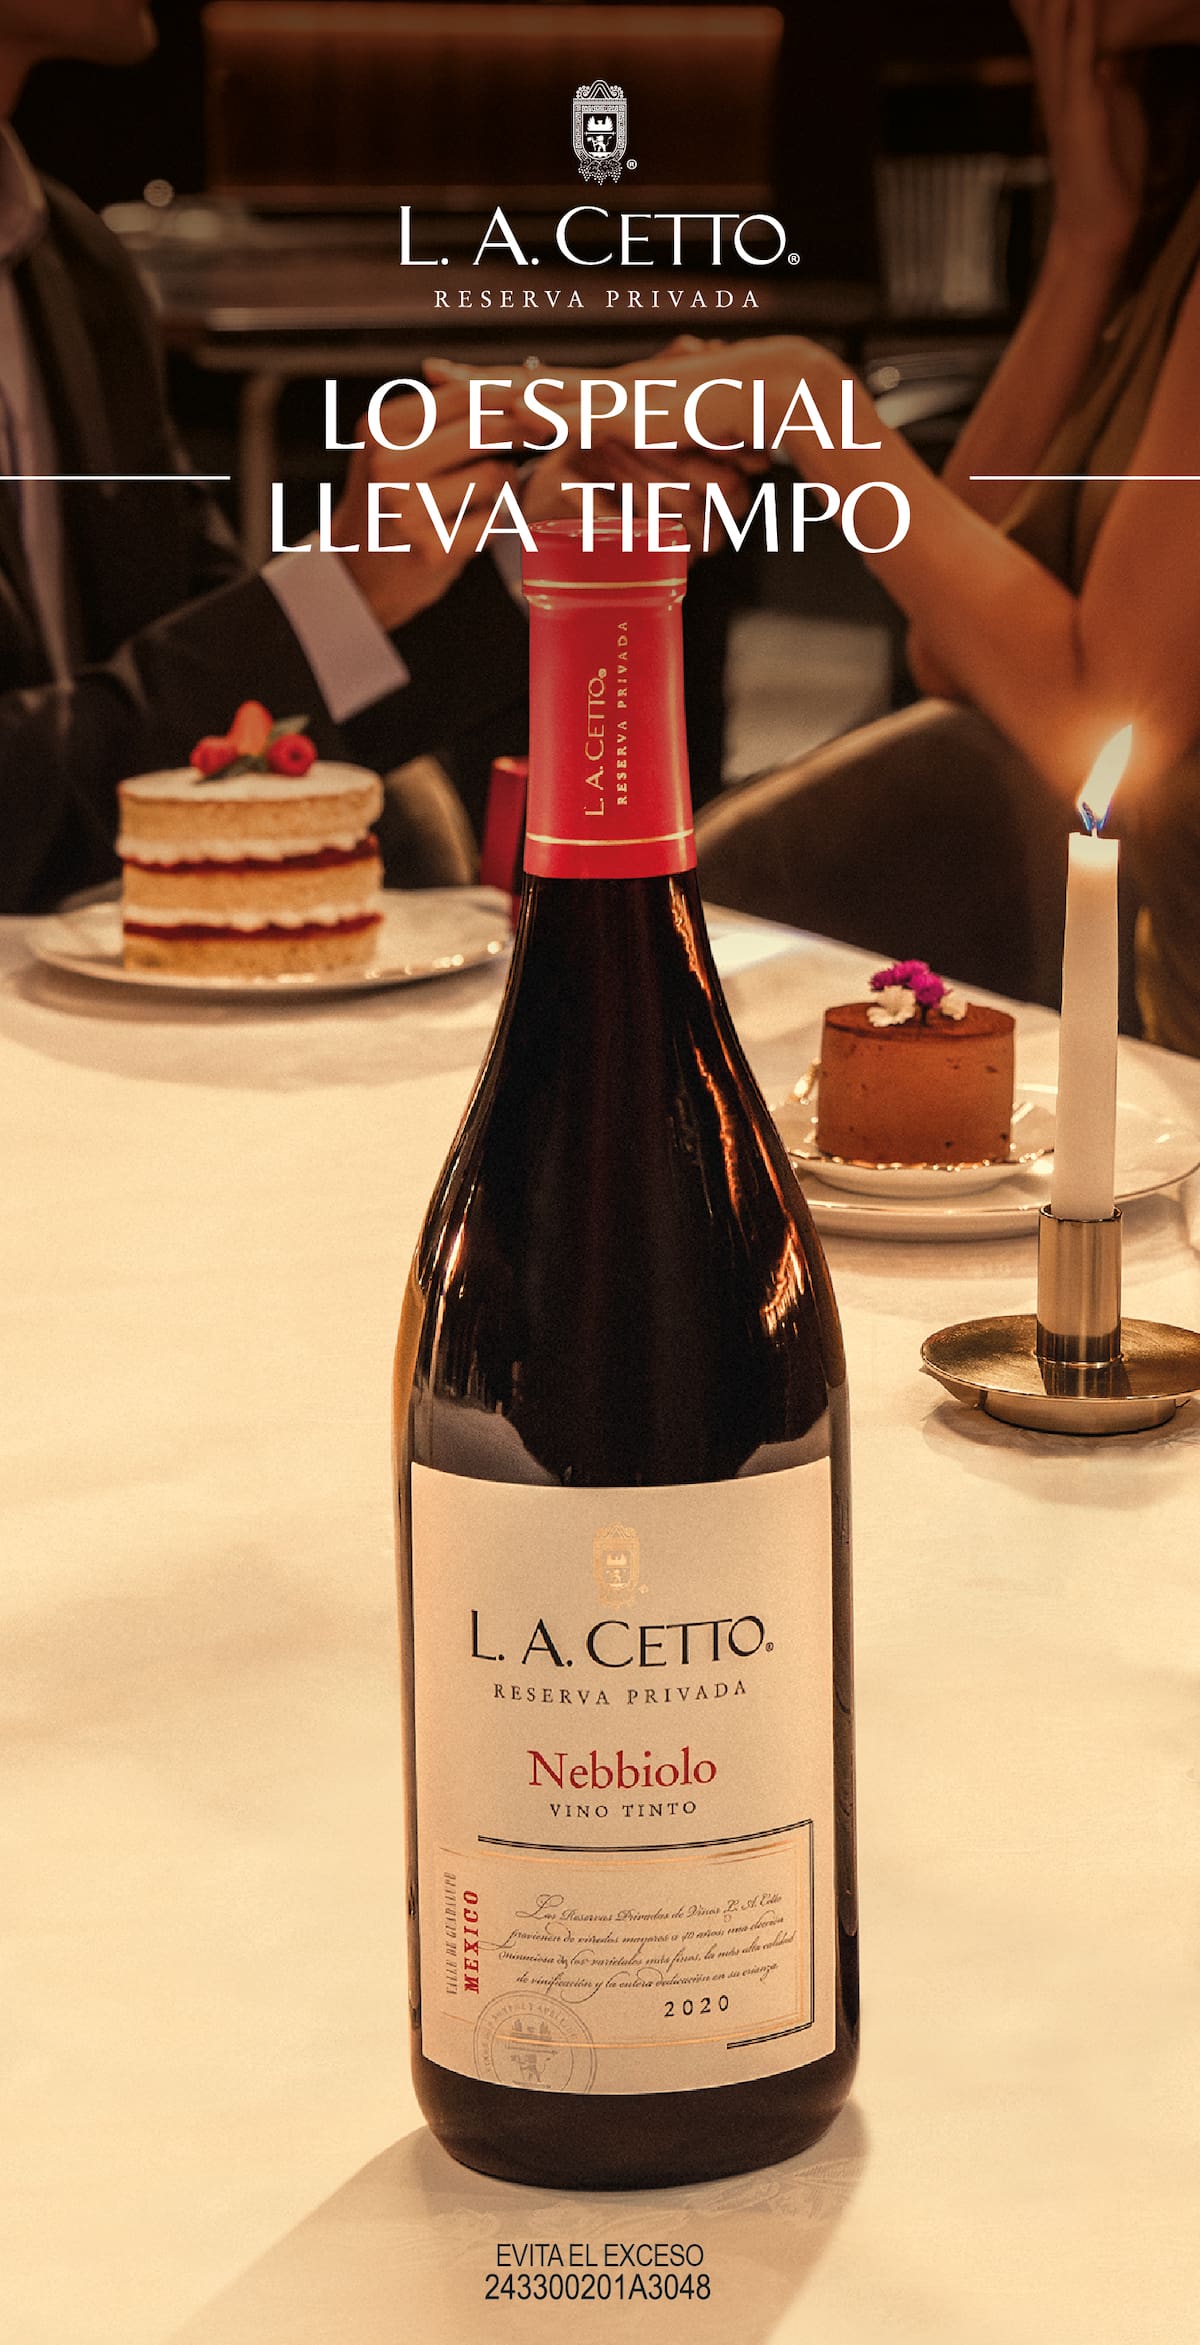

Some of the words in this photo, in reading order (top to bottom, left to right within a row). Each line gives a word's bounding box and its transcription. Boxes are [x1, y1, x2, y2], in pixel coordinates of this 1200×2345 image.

[617, 622, 628, 709] PRIVADA
[585, 766, 604, 790] A.
[617, 720, 628, 805] RESERVA
[471, 1609, 505, 1661] L.
[522, 1618, 573, 1667] A.
[494, 1683, 610, 1706] RESERVA
[627, 1680, 747, 1705] PRIVADA
[527, 1746, 717, 1789] Nebbiolo
[550, 1803, 609, 1818] VINO
[622, 1801, 697, 1818] TINTO
[515, 1894, 564, 1920] Las
[672, 1905, 684, 1919] de
[463, 1890, 479, 1994] MEXICO
[664, 1995, 730, 2018] 2020
